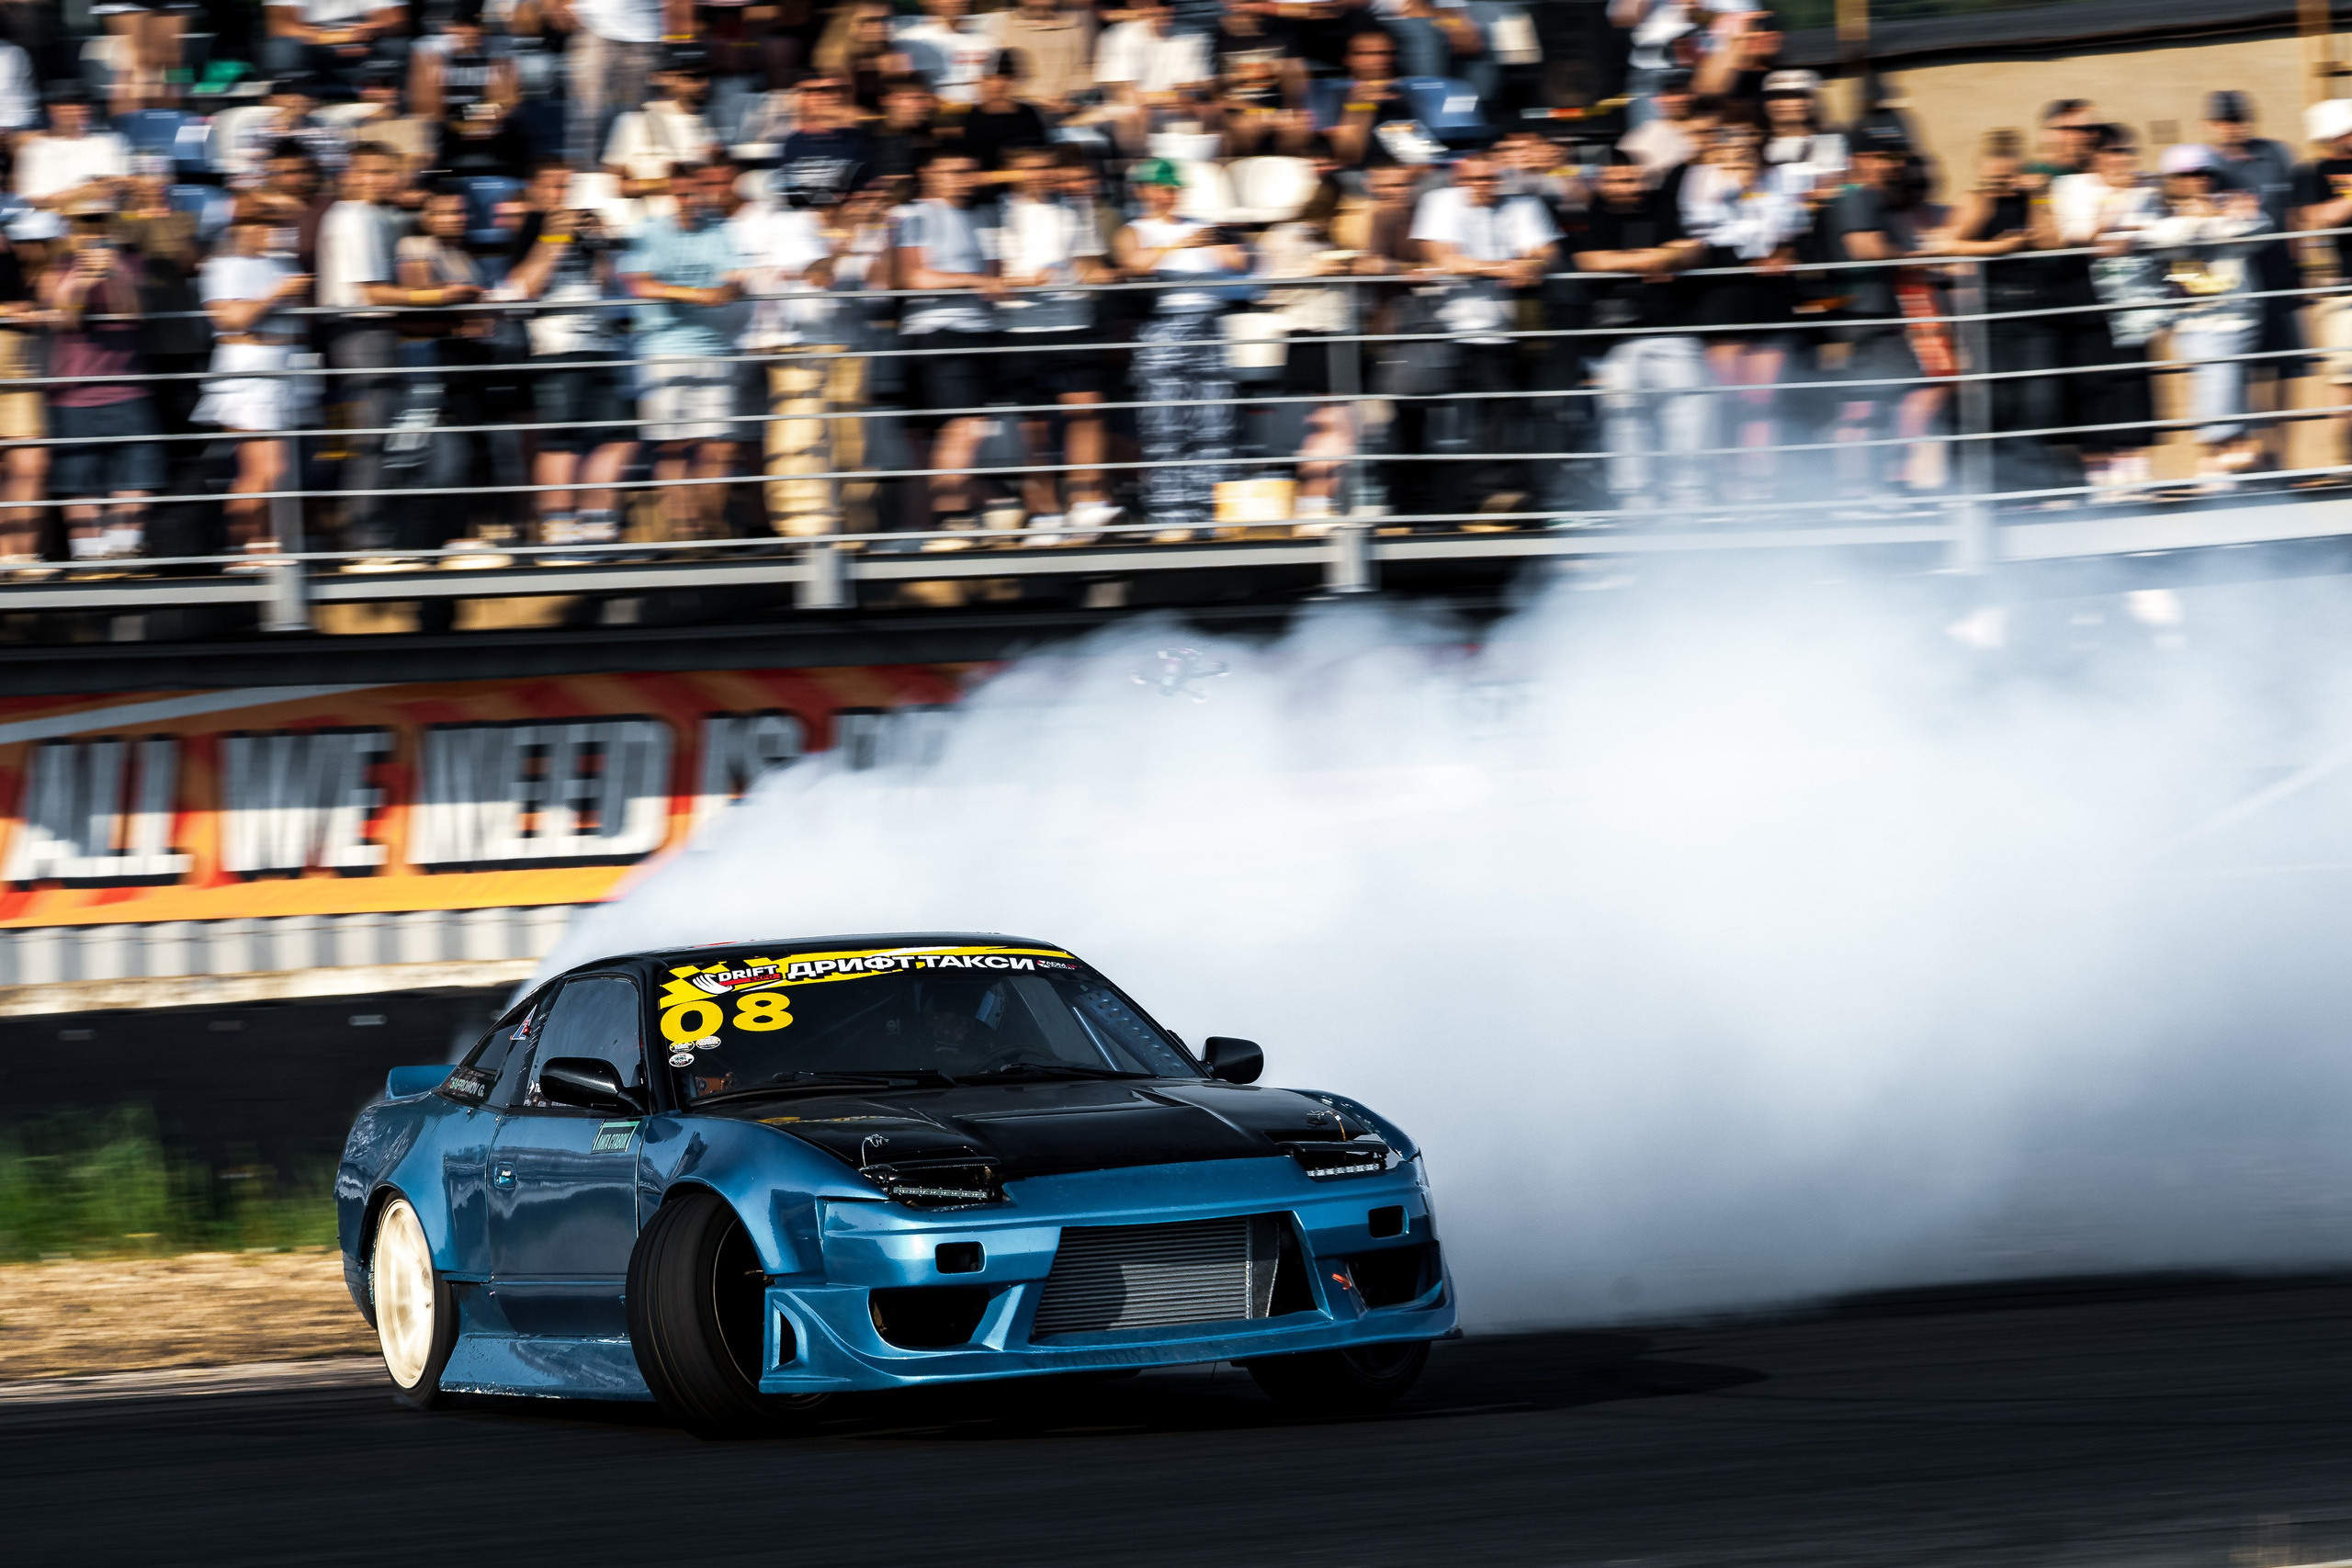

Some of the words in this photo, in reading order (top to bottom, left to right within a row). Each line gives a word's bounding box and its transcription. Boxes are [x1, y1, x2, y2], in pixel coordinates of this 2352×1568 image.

[3, 739, 194, 881] ALL
[219, 733, 395, 872] WE
[405, 720, 673, 865] NEED
[718, 964, 778, 983] DRIFT
[750, 974, 775, 982] EXPO
[787, 955, 1035, 980] ДРИФТТАКСИ
[660, 992, 794, 1043] 08
